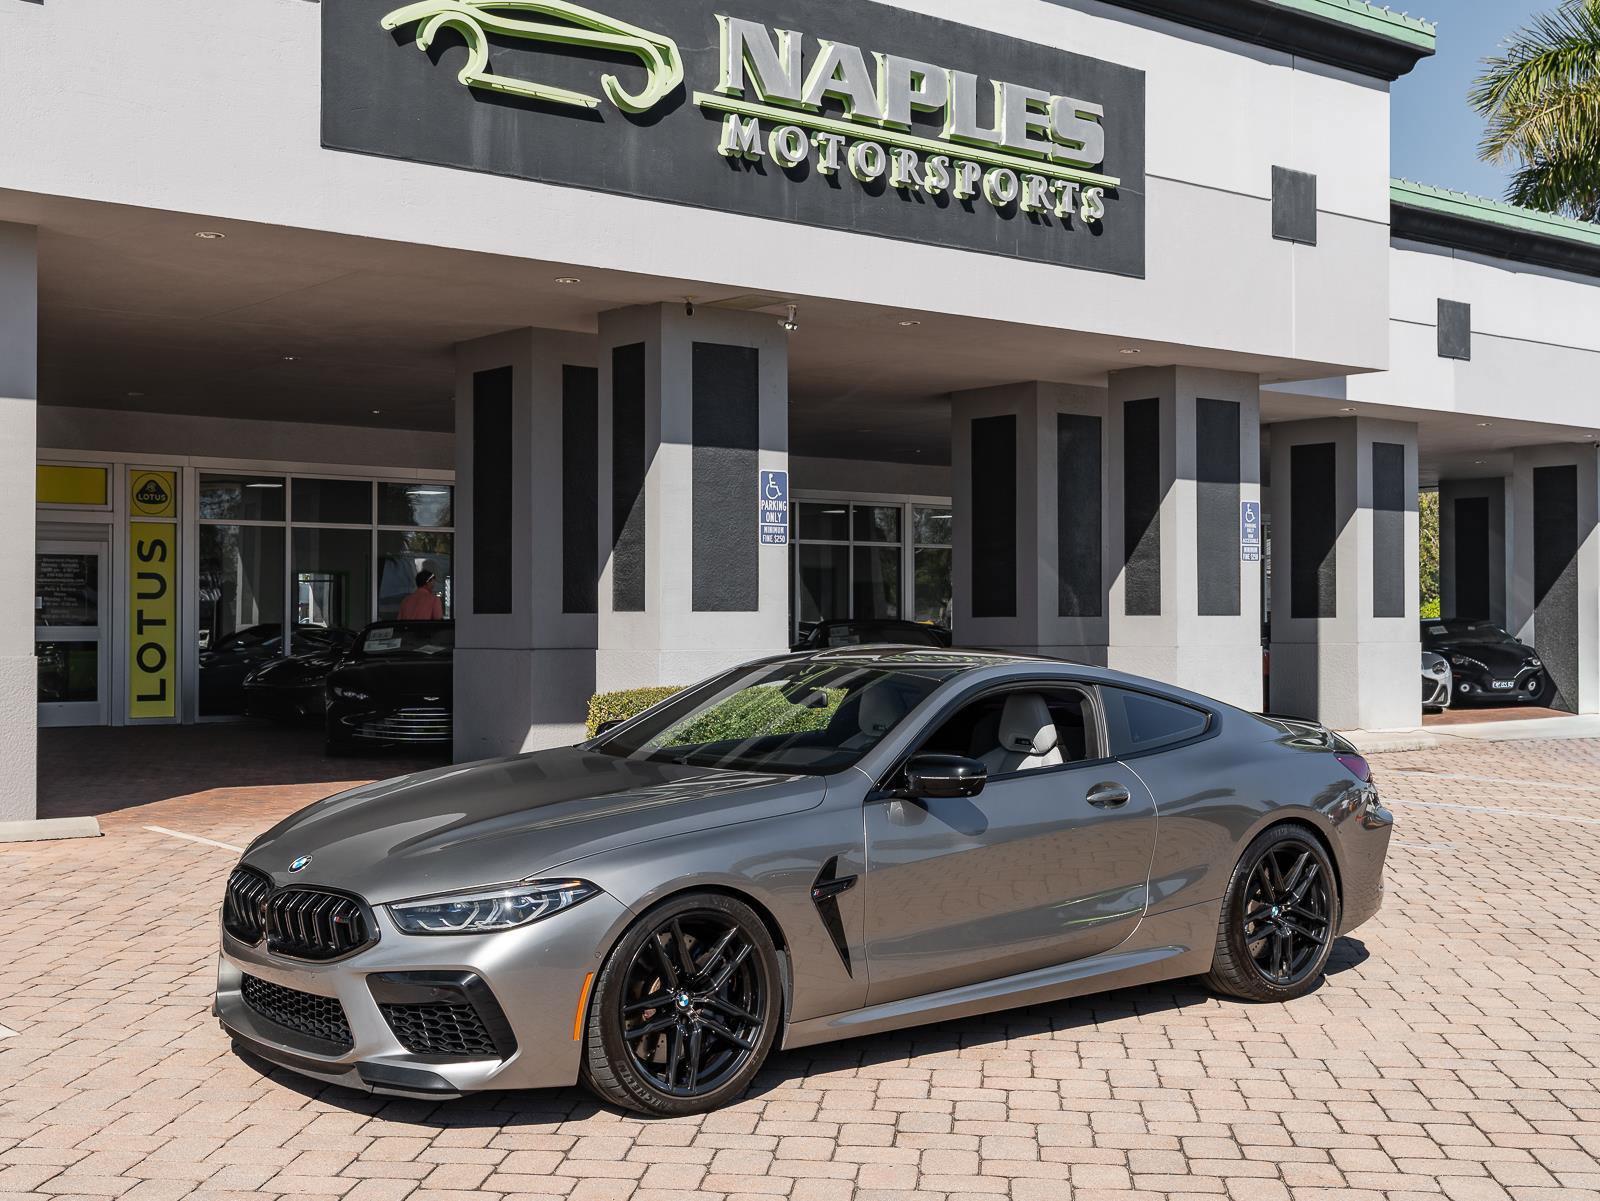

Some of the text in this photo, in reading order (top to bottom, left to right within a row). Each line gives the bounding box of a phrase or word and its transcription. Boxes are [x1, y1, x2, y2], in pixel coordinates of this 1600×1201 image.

[713, 13, 1105, 168] NAPLES
[717, 114, 1105, 224] MOTORSPORTS
[137, 493, 167, 501] LOTUS
[761, 500, 786, 511] PARKING
[765, 512, 782, 522] ONLY
[762, 535, 785, 543] FINE $250
[136, 538, 167, 702] LOTUS
